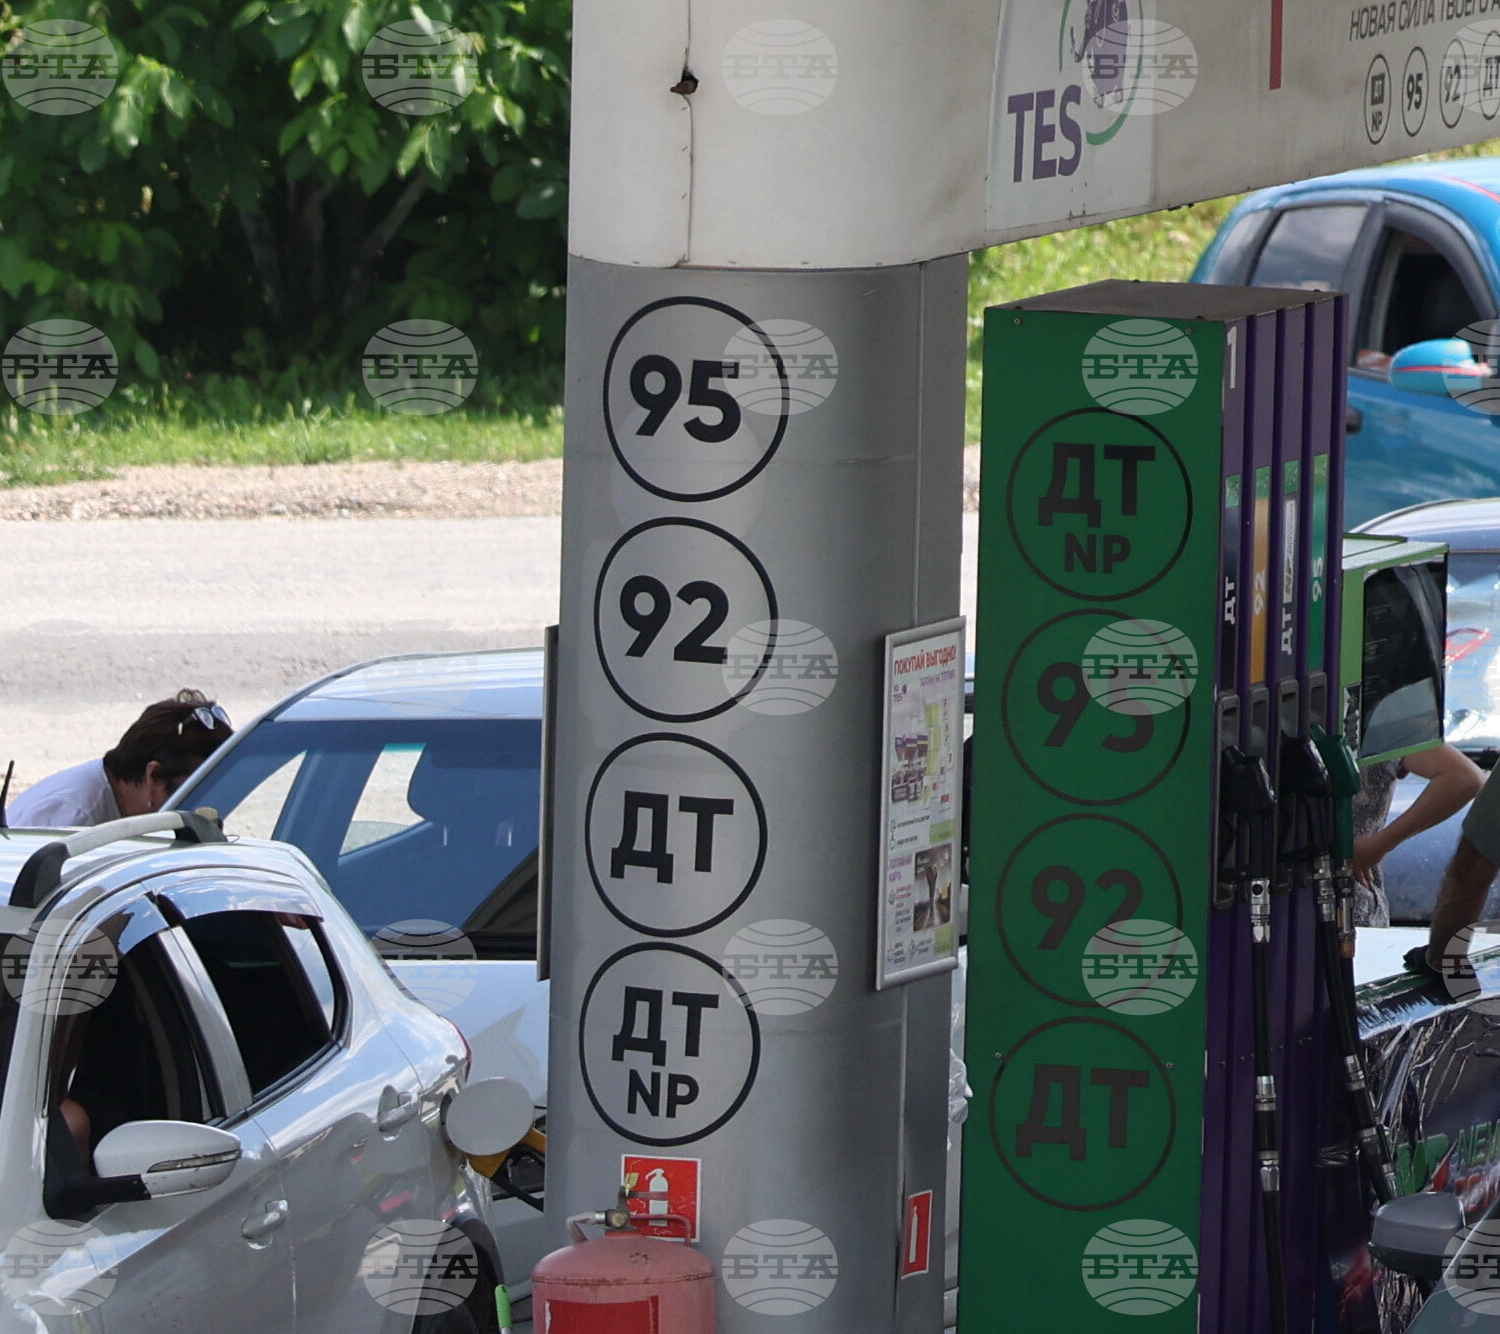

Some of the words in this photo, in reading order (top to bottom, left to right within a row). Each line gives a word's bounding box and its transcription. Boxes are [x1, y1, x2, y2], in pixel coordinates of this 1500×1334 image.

[1350, 1, 1397, 42] НОВАЯ
[1406, 72, 1423, 112] 95
[1443, 64, 1461, 104] 92
[1007, 84, 1082, 183] TES
[1227, 326, 1237, 389] 1
[629, 354, 741, 443] 95
[1038, 441, 1156, 528] ДТ
[1064, 533, 1131, 574] NP
[1312, 557, 1323, 603] 95
[619, 575, 730, 664] 92
[1224, 577, 1236, 624] ДТ
[1254, 570, 1266, 615] 92
[1281, 603, 1293, 655] ДТ
[894, 649, 925, 676] ПОКУПАЙ
[1037, 661, 1157, 753] 95
[610, 790, 734, 884] ДТ
[1031, 865, 1144, 954] 92
[612, 986, 719, 1066] ДТ
[627, 1069, 699, 1118] NP
[1015, 1063, 1150, 1161] ДТ
